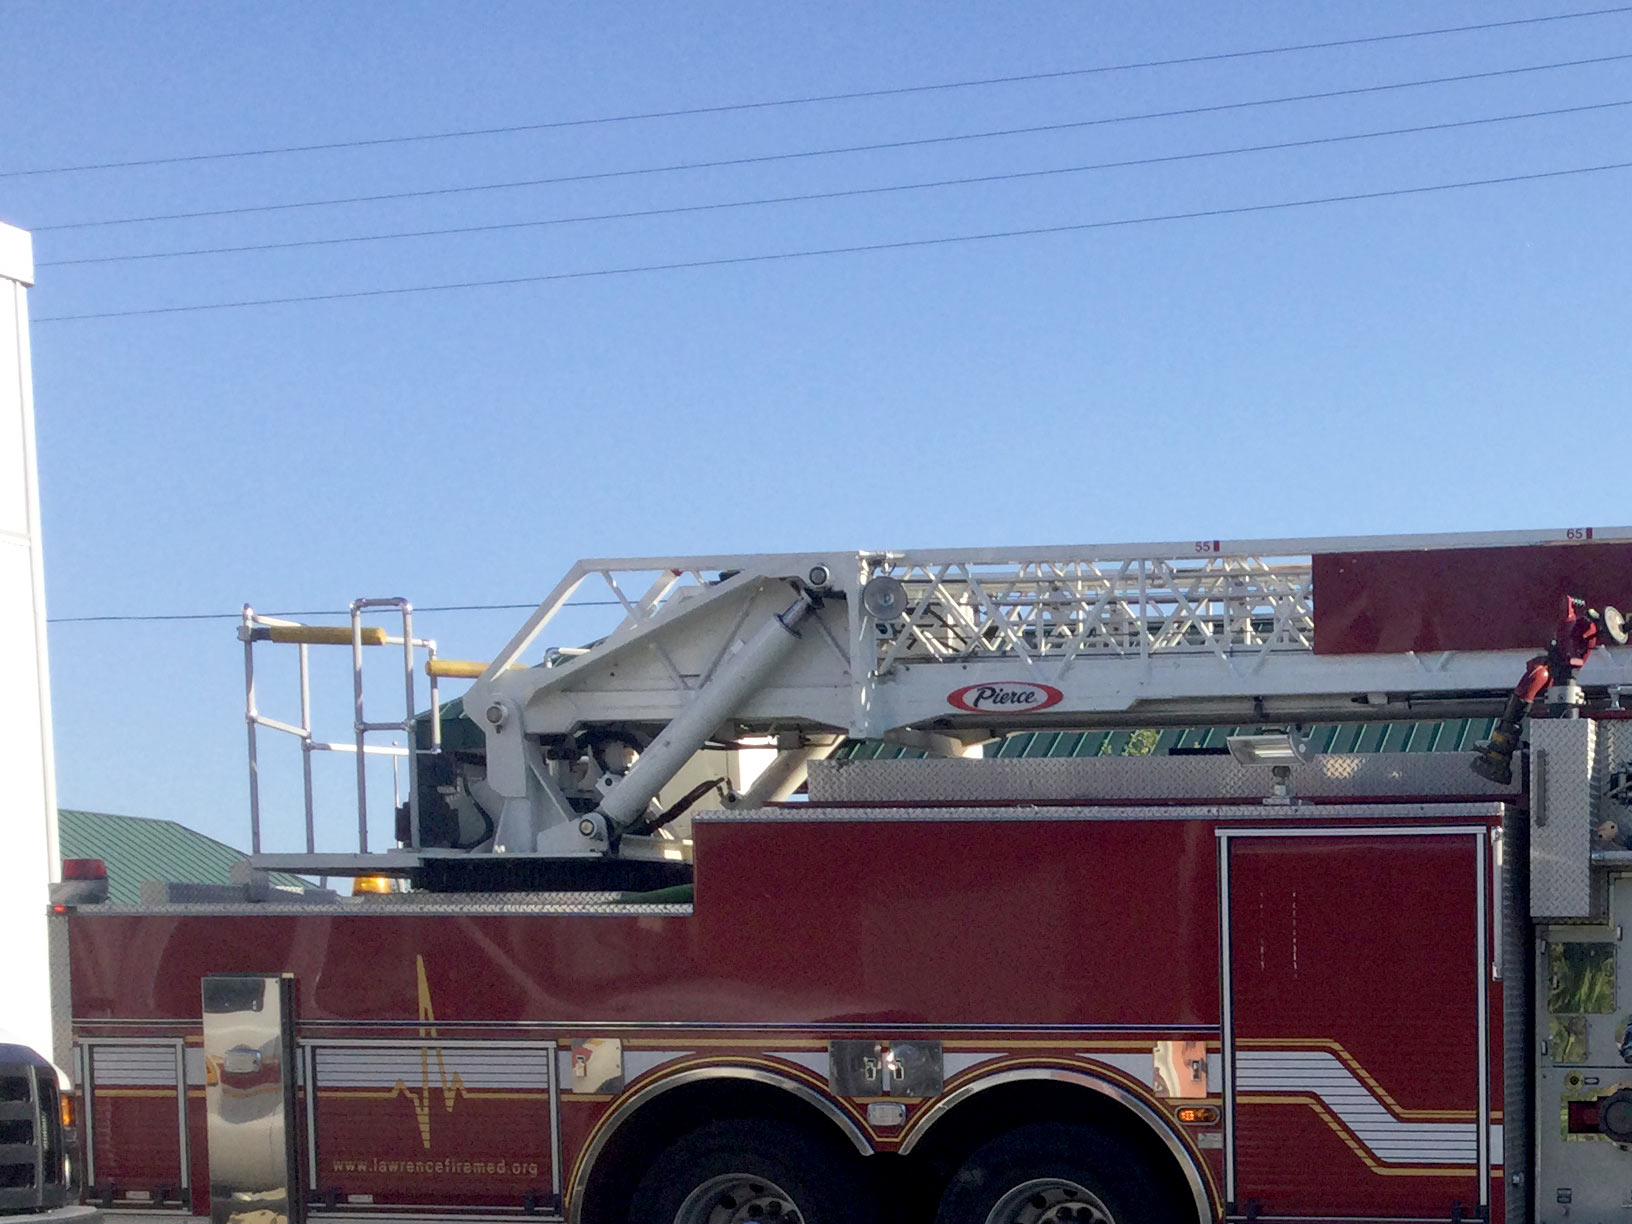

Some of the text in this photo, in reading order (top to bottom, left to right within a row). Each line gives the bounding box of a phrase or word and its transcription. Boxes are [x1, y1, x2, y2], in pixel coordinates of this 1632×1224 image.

[1567, 527, 1583, 539] 65
[1195, 540, 1211, 553] 55
[973, 686, 1036, 708] Pierce
[333, 1158, 538, 1177] www.lawrencefiremed.org
